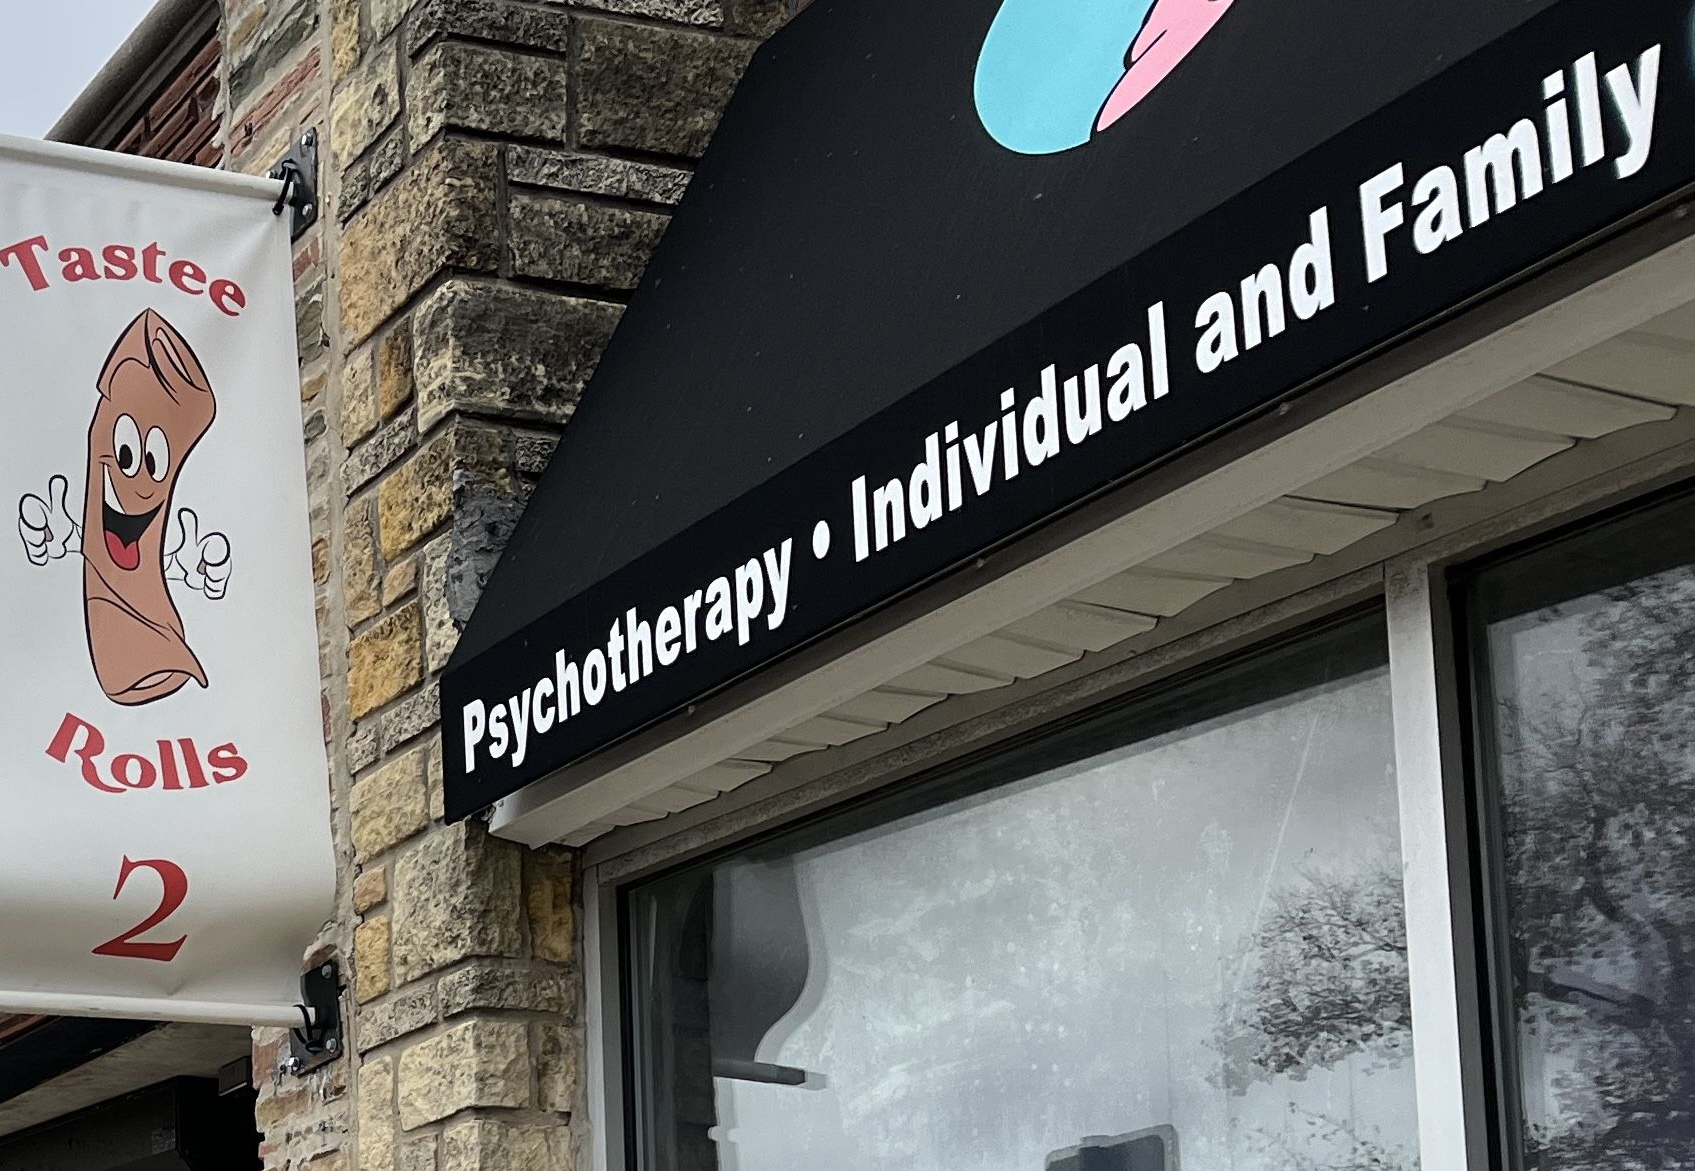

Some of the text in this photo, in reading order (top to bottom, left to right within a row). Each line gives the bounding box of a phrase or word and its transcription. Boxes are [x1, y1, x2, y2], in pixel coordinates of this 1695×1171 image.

[463, 43, 1661, 773] Psychotherapy Individual and Family
[45, 712, 248, 793] Rolls
[91, 854, 188, 962] 2
